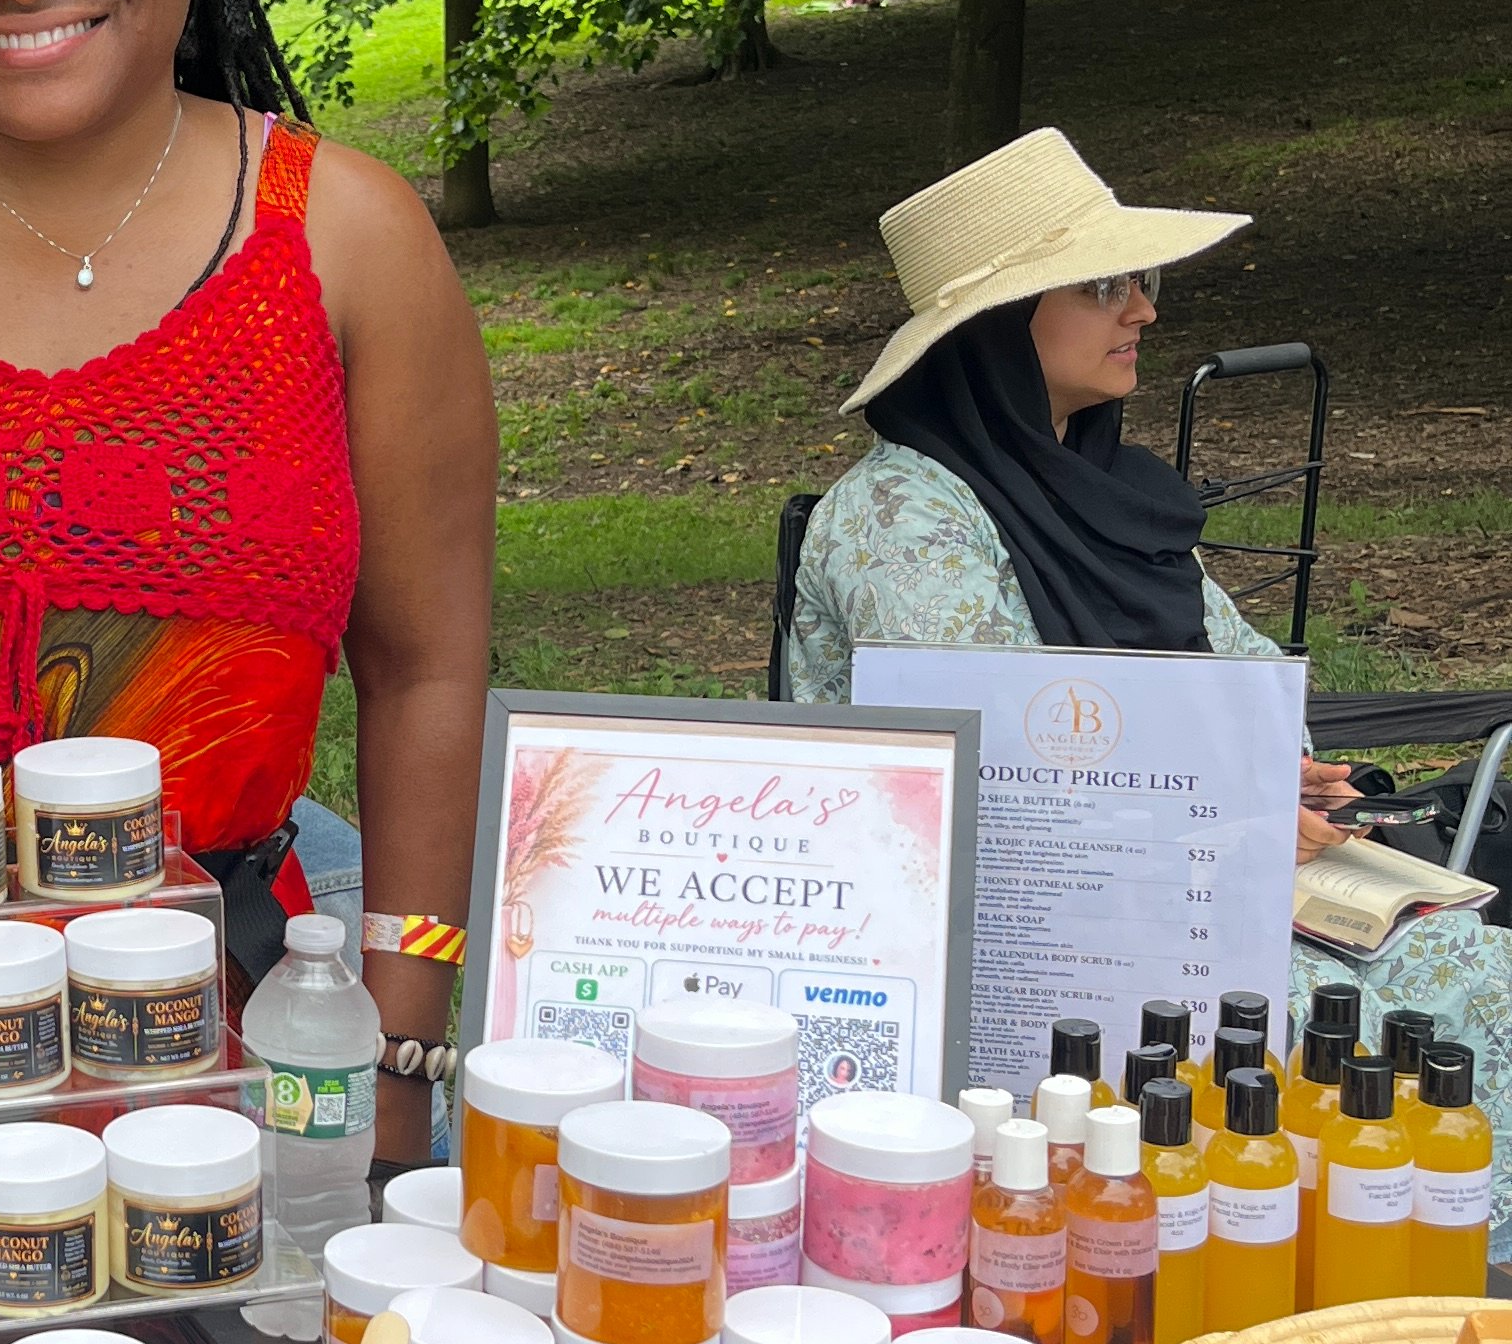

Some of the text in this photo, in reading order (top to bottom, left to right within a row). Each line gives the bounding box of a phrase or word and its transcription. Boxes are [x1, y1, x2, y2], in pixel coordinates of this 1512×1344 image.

[1035, 733, 1110, 746] ANGELA'S
[979, 765, 1199, 791] ODUCT PRICE LIST
[605, 767, 843, 828] Angela's
[987, 794, 1019, 805] SHEA
[1023, 796, 1071, 807] BUTTER
[1189, 805, 1218, 819] $25
[41, 832, 108, 856] Angela's
[638, 829, 811, 854] BOUTIQUE
[995, 838, 1027, 848] KOJIC
[1029, 839, 1067, 850] FACIAL
[1069, 842, 1123, 853] CLEANSER
[1188, 849, 1216, 863] $25
[595, 864, 855, 910] WE ACCEPT
[984, 876, 1104, 892] HONEY OATMEAL SOAP
[1186, 889, 1212, 903] $12
[592, 901, 872, 949] multiple ways to pay!
[978, 912, 1045, 925] BLACK SOAP
[1189, 927, 1209, 940] $8
[574, 935, 868, 967] THANK YOU FOR SUPPORTING MY SMALL BUSINESS!
[990, 949, 1049, 962] CALENDULA
[1051, 953, 1078, 963] BODY
[1081, 956, 1113, 966] SCRUB
[549, 960, 629, 978] CASH APP
[1182, 963, 1210, 977] $30
[704, 976, 744, 999] Pay
[804, 985, 888, 1007] venmo
[971, 983, 990, 993] OSE
[992, 985, 1027, 996] SUGAR
[1030, 988, 1058, 998] BODY
[1060, 990, 1093, 1001] SCRUB
[145, 994, 204, 1015] COCONUT
[72, 1005, 129, 1033] Angela's
[154, 1008, 200, 1027] MANGO
[983, 1017, 1008, 1027] HAIR
[1020, 1020, 1049, 1030] BODY
[979, 1046, 1041, 1059] BATH SALTS
[129, 1222, 202, 1250] Angela's
